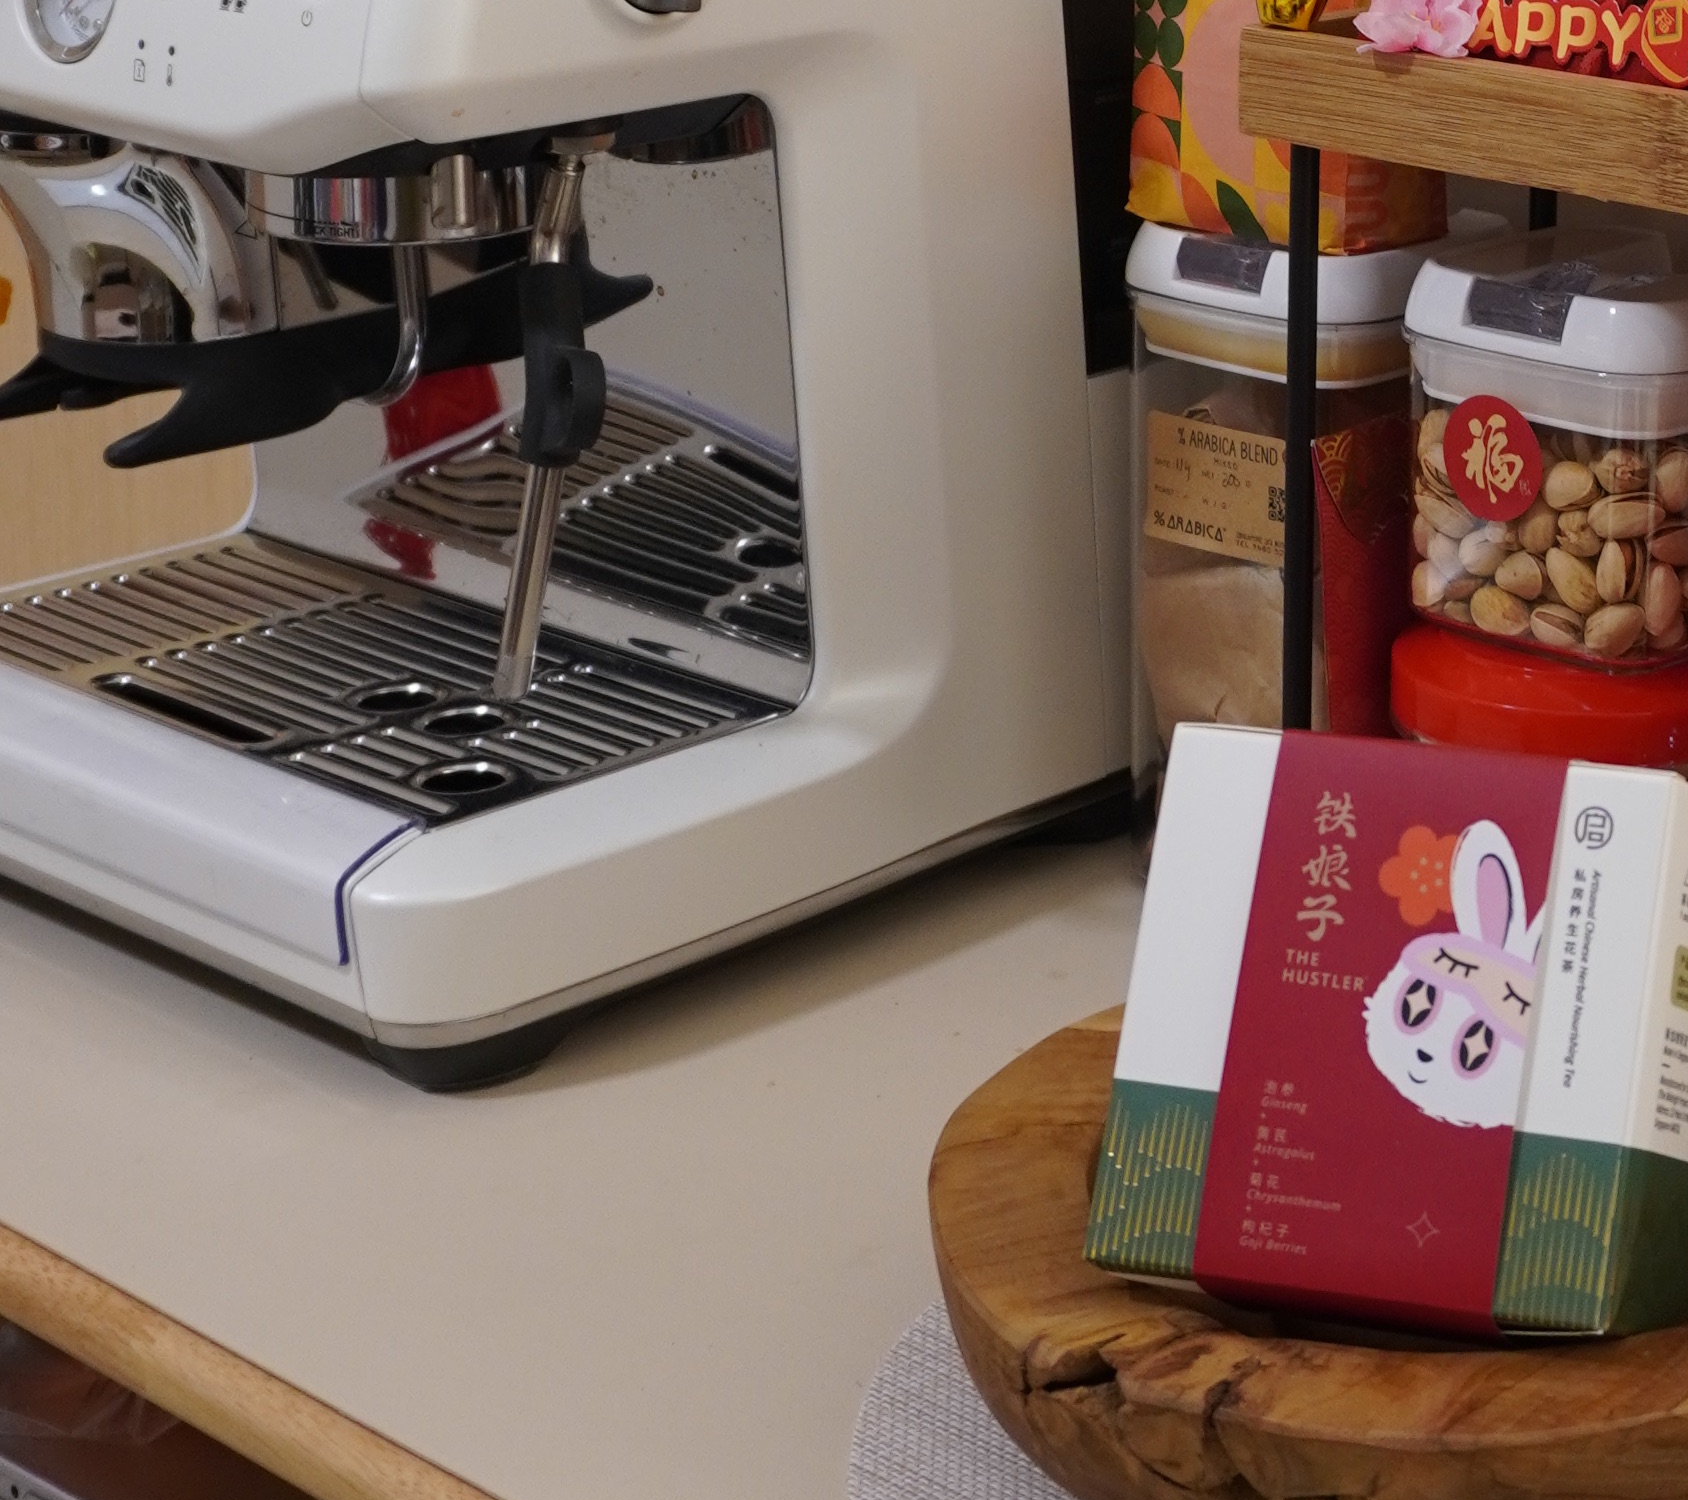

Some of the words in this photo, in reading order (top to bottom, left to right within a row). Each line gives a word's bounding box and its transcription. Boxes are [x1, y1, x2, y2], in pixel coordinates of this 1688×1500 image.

[1189, 429, 1237, 457] ARABICA
[1240, 441, 1278, 466] BLEND
[1461, 413, 1524, 503] 福
[1296, 791, 1357, 942] 铁娘子
[1285, 948, 1320, 967] THE
[1282, 967, 1365, 992] HUSTLER
